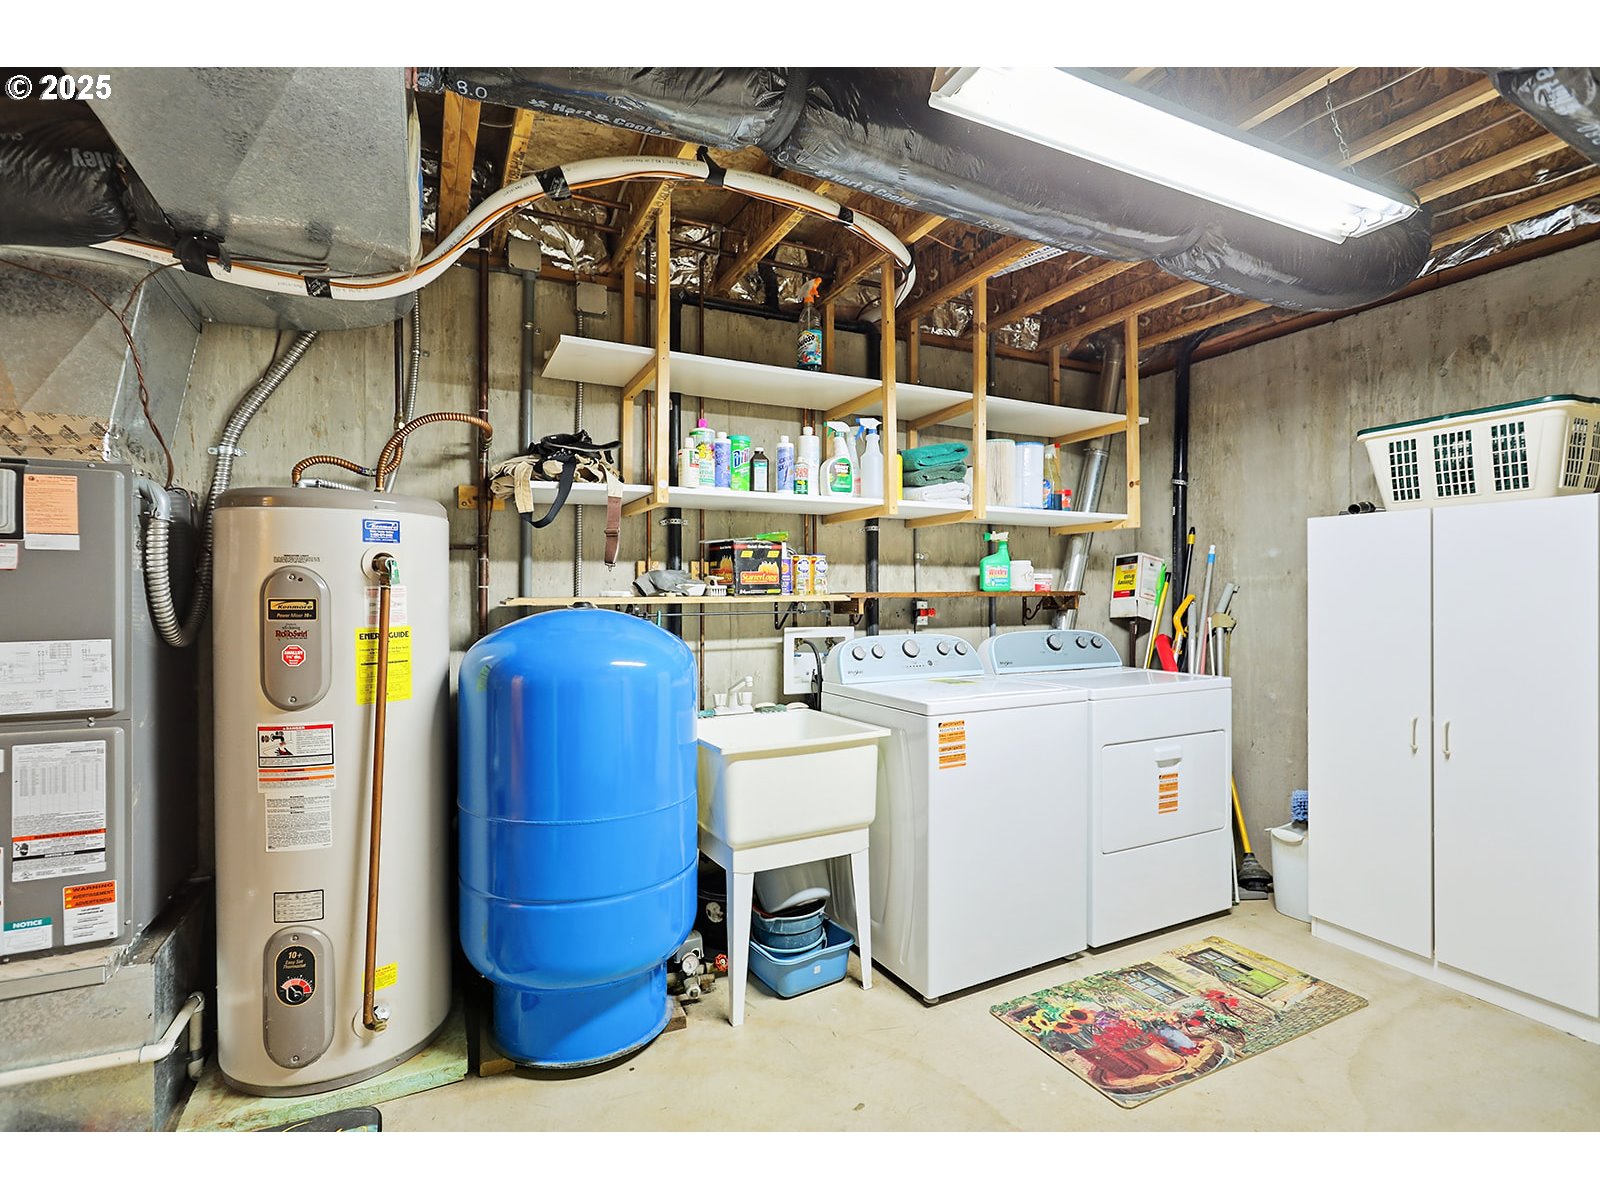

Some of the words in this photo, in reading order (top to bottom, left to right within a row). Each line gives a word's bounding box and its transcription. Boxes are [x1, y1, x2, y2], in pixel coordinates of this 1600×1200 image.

[456, 80, 488, 99] 8.0
[552, 103, 592, 117] Hart
[613, 117, 673, 136] Cooley
[73, 883, 114, 892] WARNING
[12, 919, 43, 929] NOTICE
